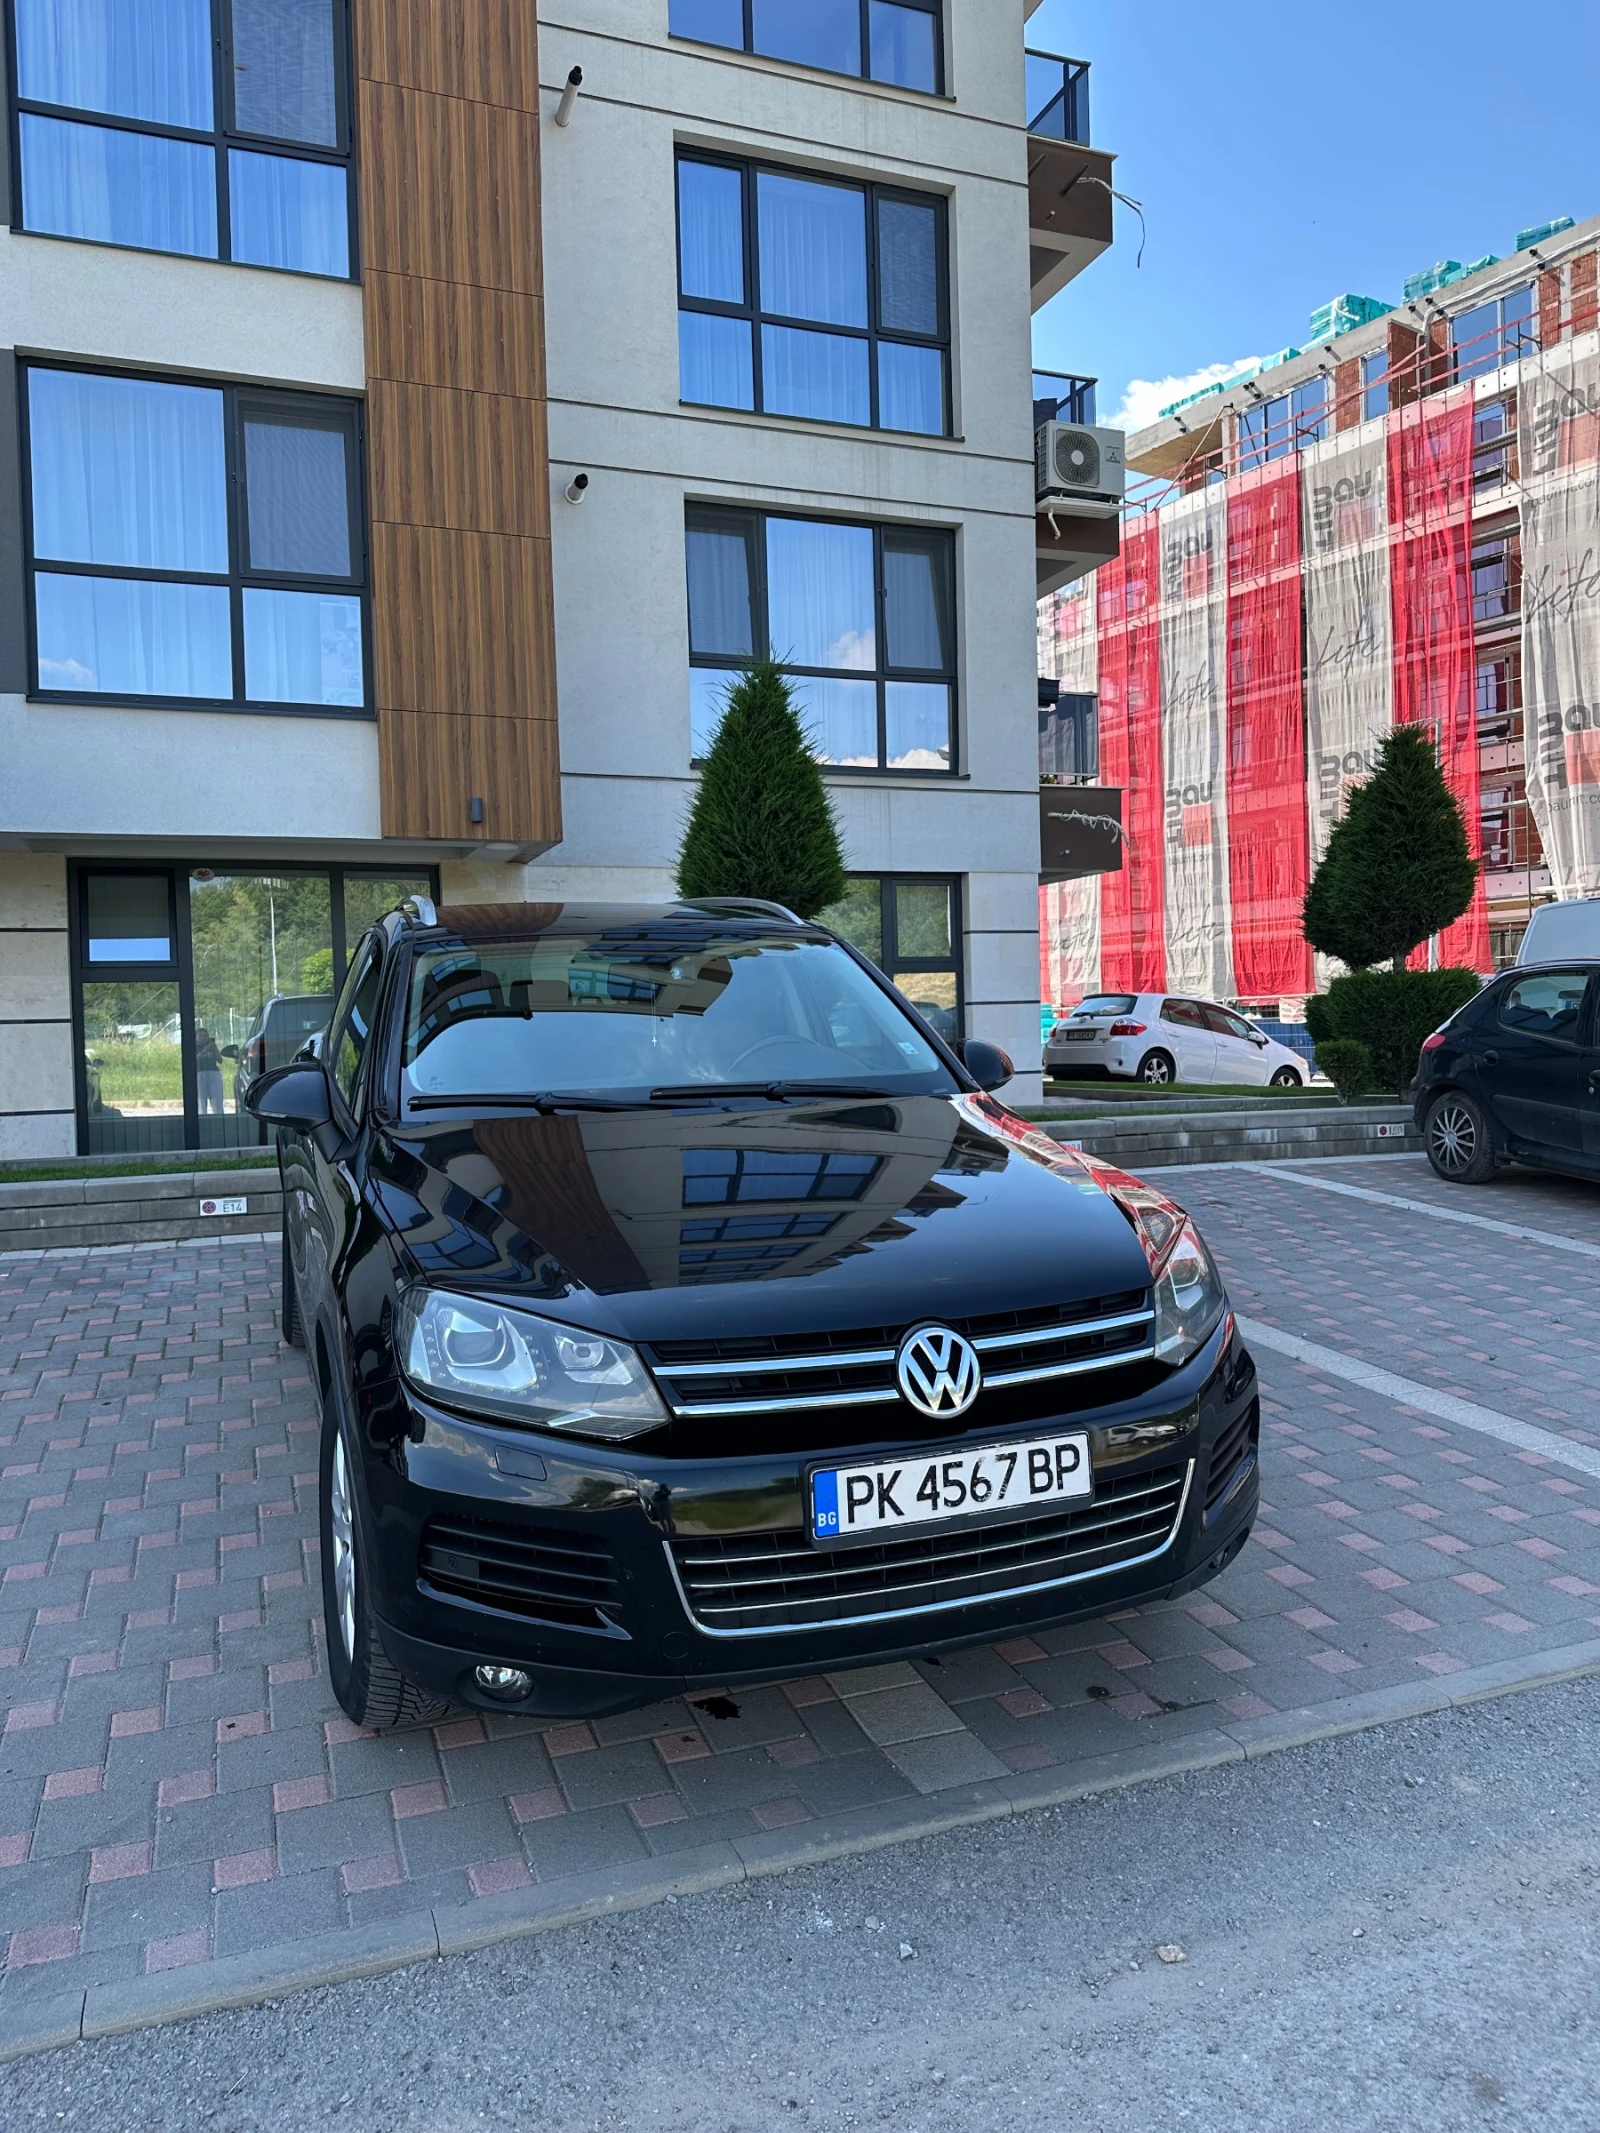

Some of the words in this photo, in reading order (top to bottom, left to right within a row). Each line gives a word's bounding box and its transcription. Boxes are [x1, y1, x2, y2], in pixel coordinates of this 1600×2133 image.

[223, 1203, 242, 1213] E14
[846, 1469, 905, 1524] PK
[916, 1452, 1018, 1511] 4567
[1028, 1443, 1081, 1495] BP
[817, 1511, 837, 1527] BG
